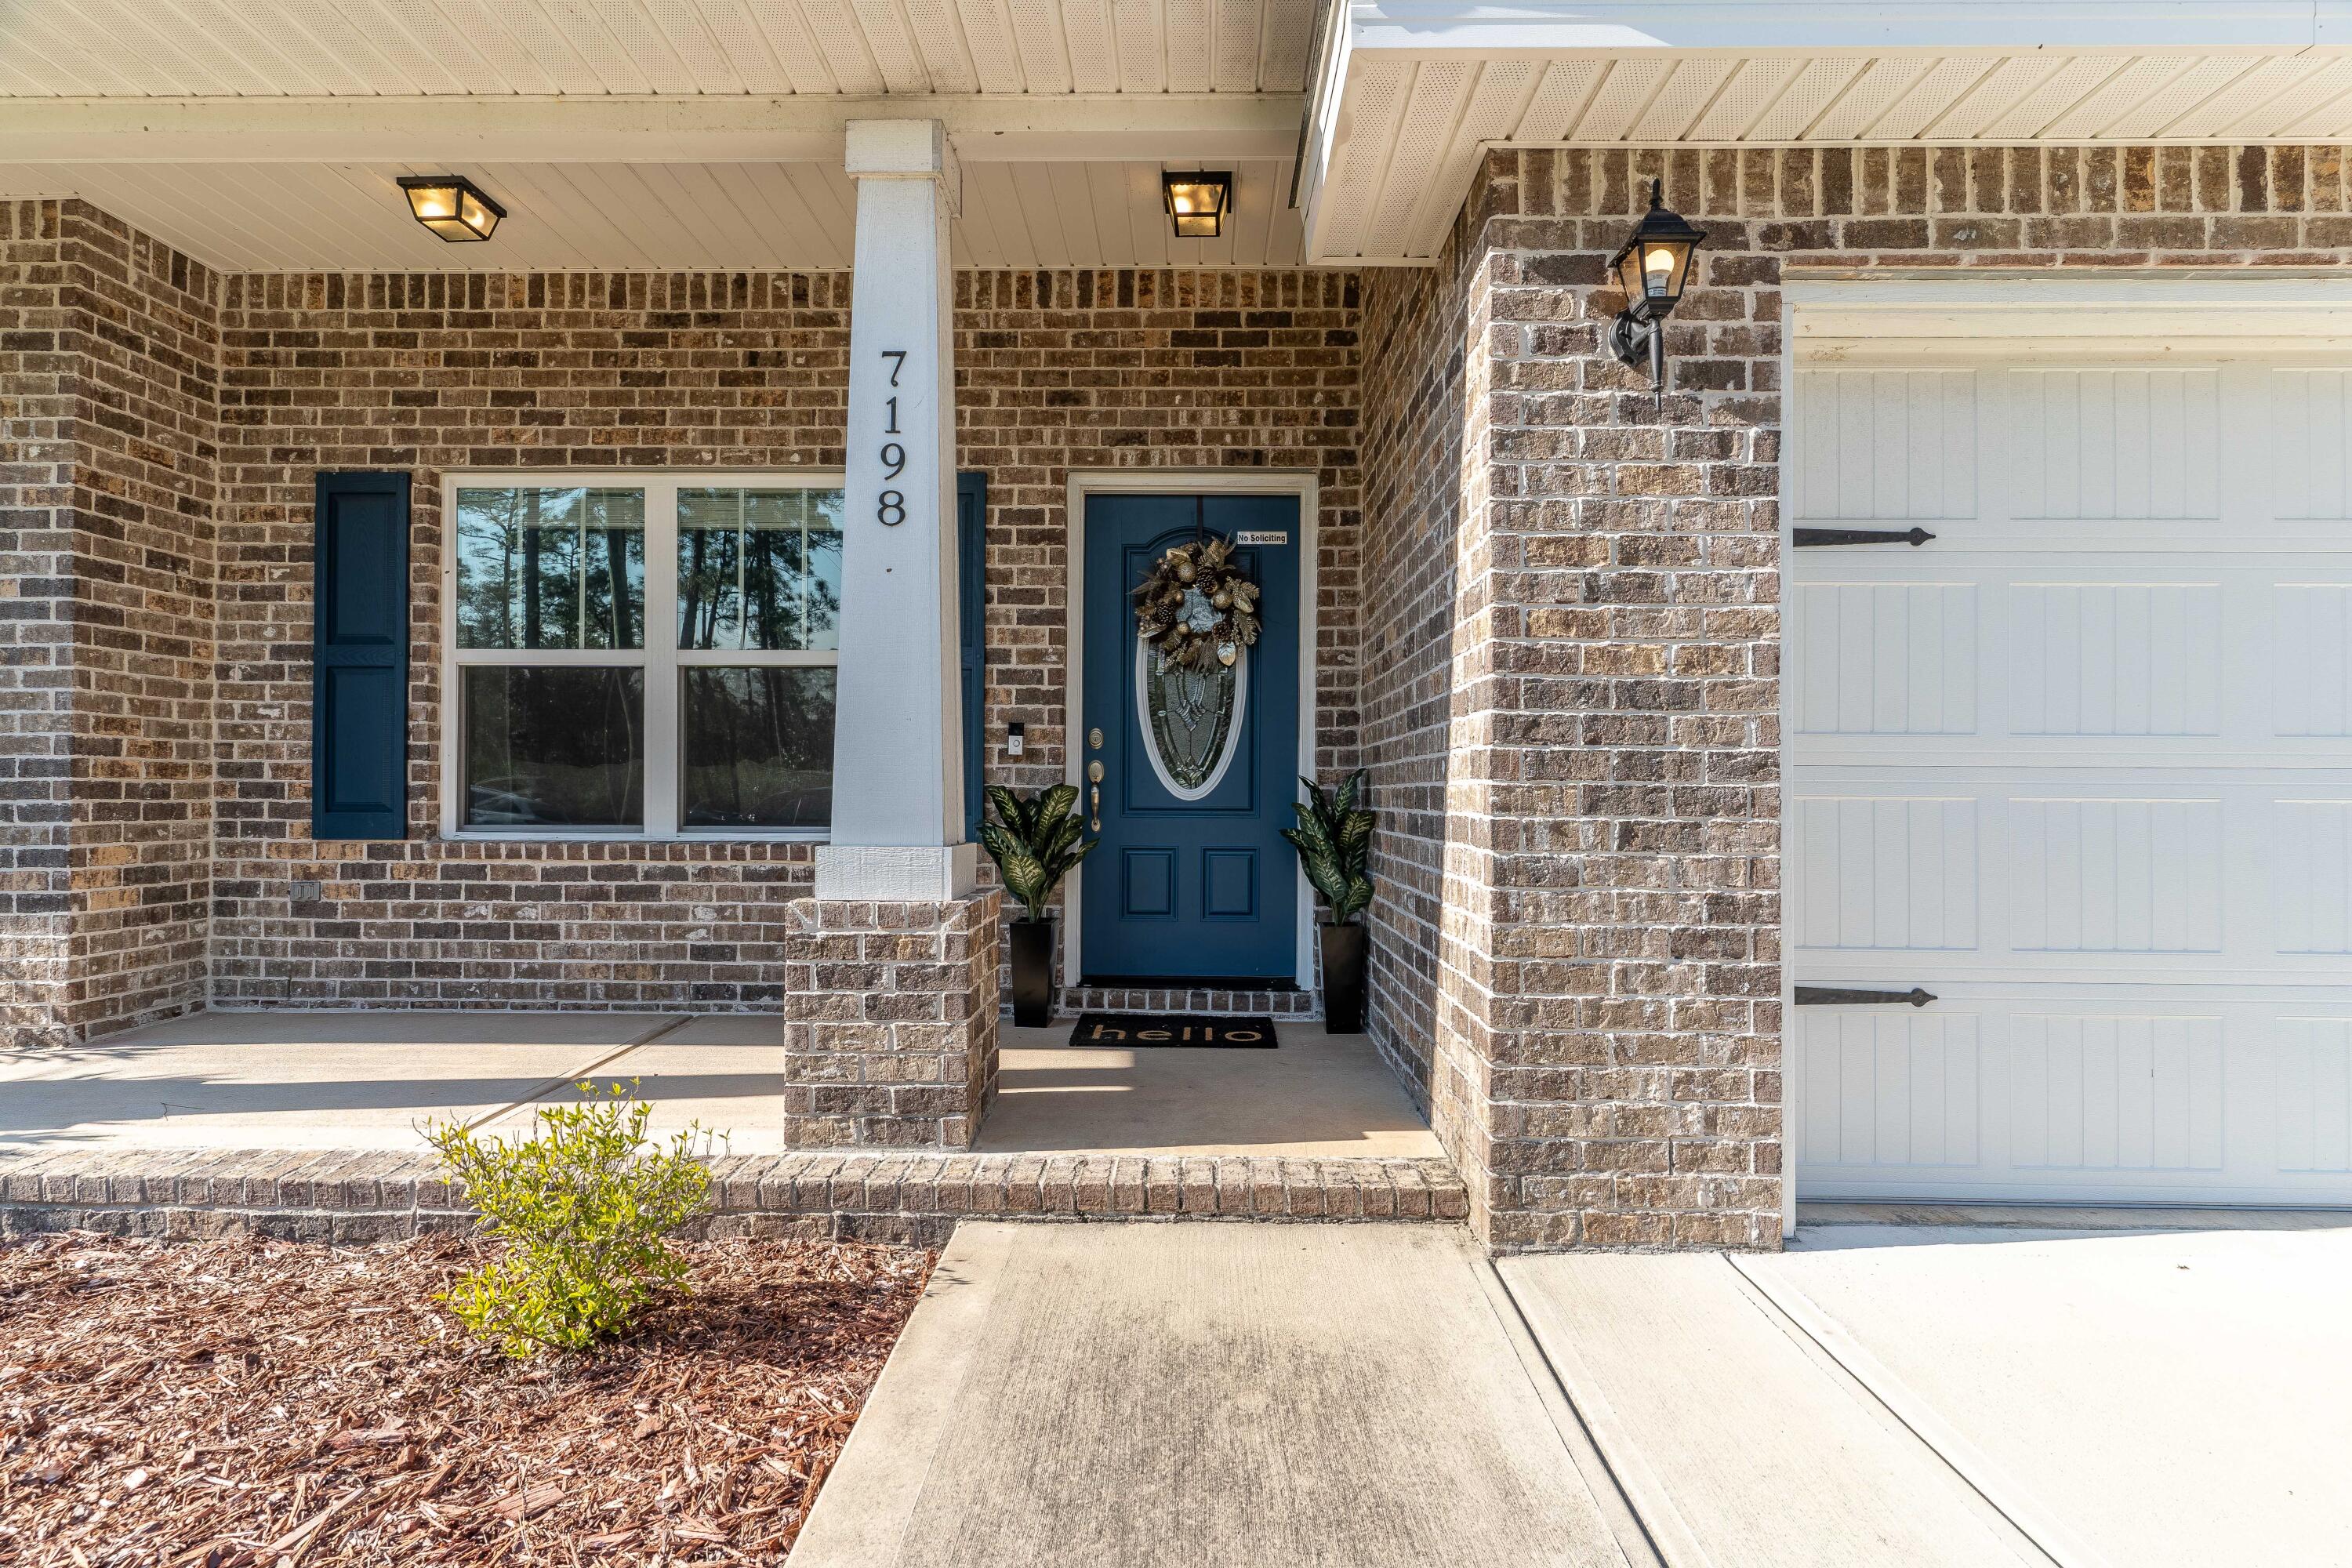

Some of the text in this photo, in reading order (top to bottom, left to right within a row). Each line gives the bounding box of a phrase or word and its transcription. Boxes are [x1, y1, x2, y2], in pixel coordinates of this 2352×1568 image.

[877, 350, 907, 527] 7198
[1250, 534, 1286, 543] Soliciting
[1091, 1024, 1262, 1042] hello
